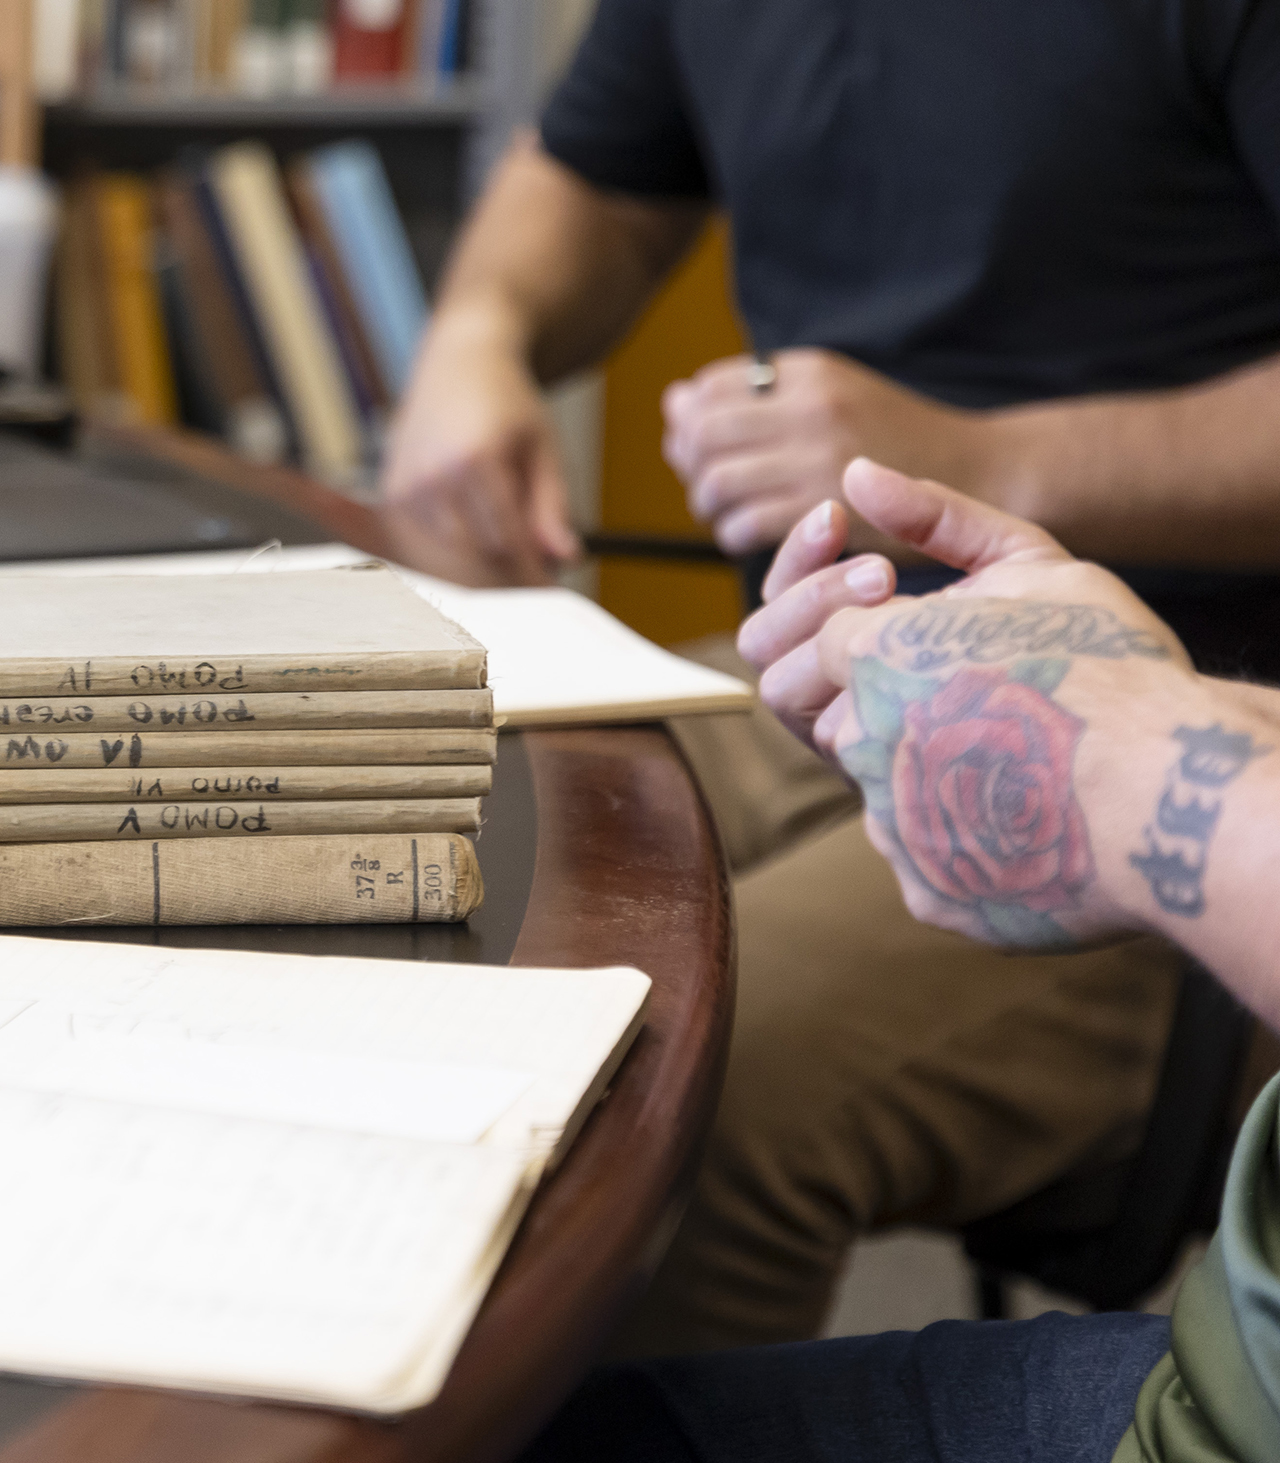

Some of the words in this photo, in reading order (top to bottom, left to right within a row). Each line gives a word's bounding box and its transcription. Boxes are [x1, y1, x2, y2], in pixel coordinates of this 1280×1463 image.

[57, 660, 91, 691] IV
[131, 661, 249, 690] POMO
[127, 699, 256, 725] POMO
[100, 732, 142, 767] VI
[117, 807, 141, 834] V
[161, 804, 272, 833] POMO
[386, 870, 404, 885] R
[424, 863, 442, 901] 300
